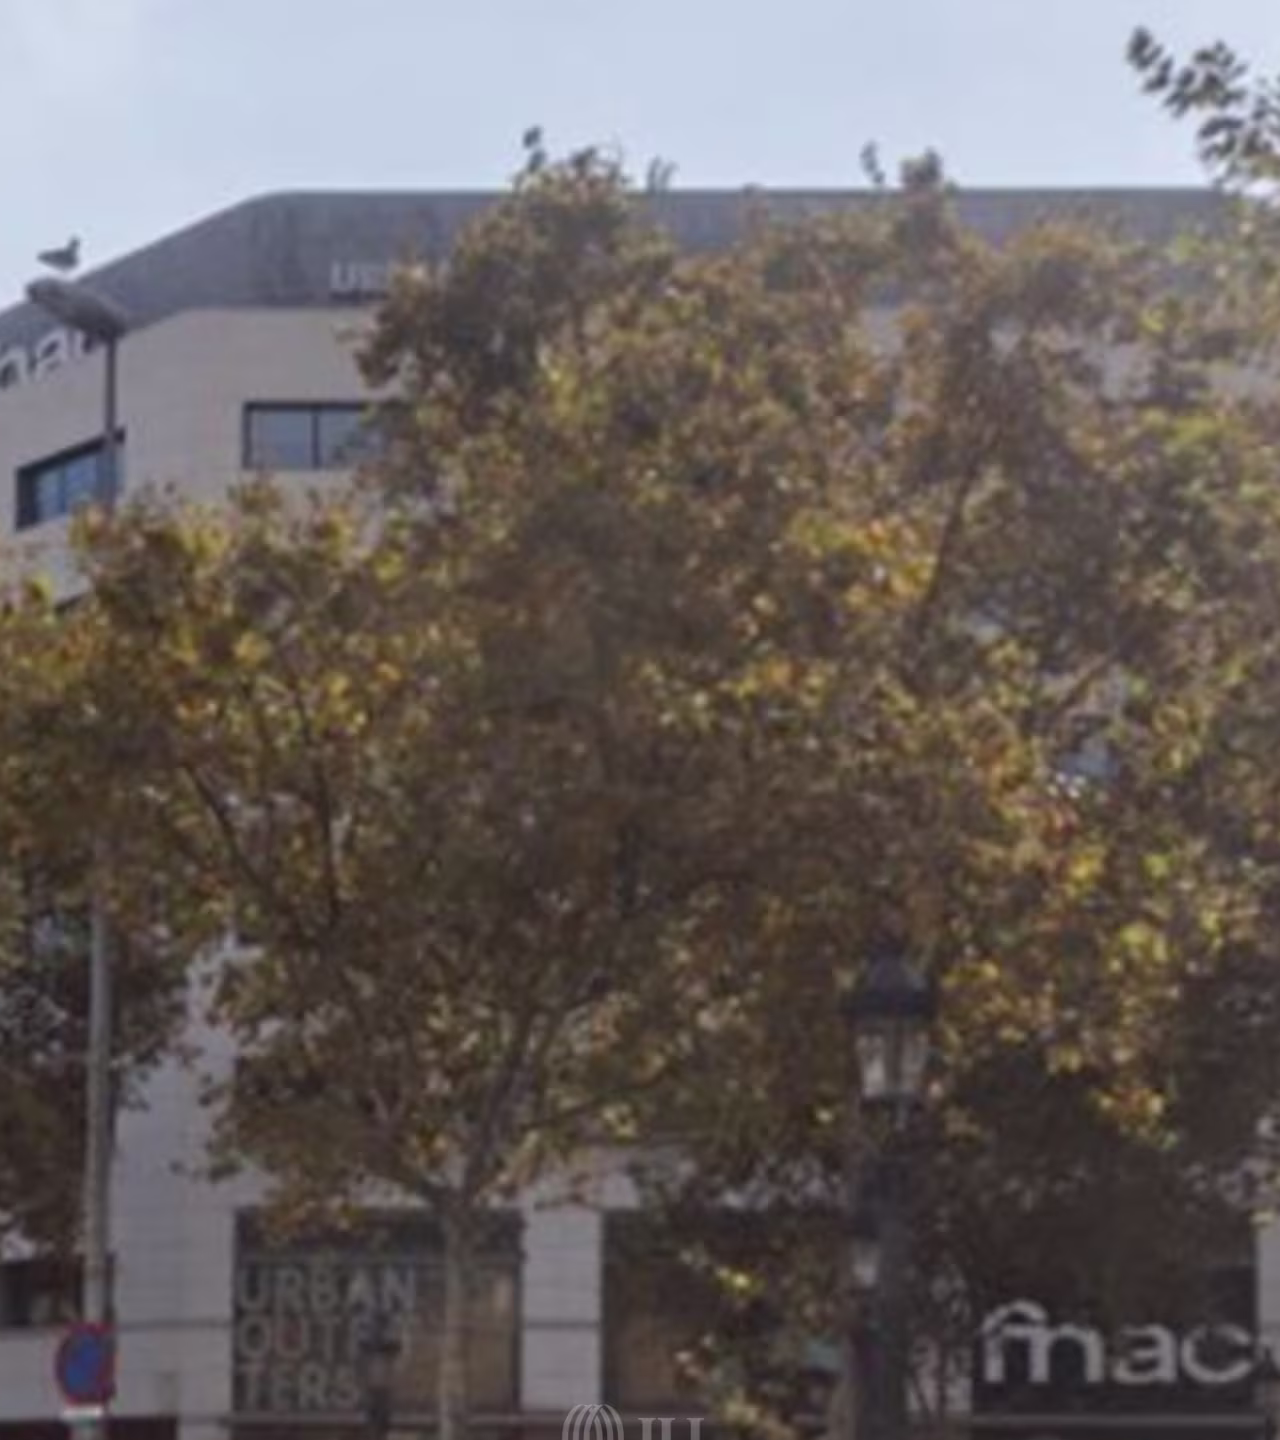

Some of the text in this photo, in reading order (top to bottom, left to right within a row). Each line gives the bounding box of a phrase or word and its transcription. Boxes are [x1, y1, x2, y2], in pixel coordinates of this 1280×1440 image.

[239, 1266, 416, 1312] URBAN
[238, 1313, 420, 1364] OUTFT
[978, 1299, 1254, 1384] fnac
[238, 1361, 361, 1409] TERS
